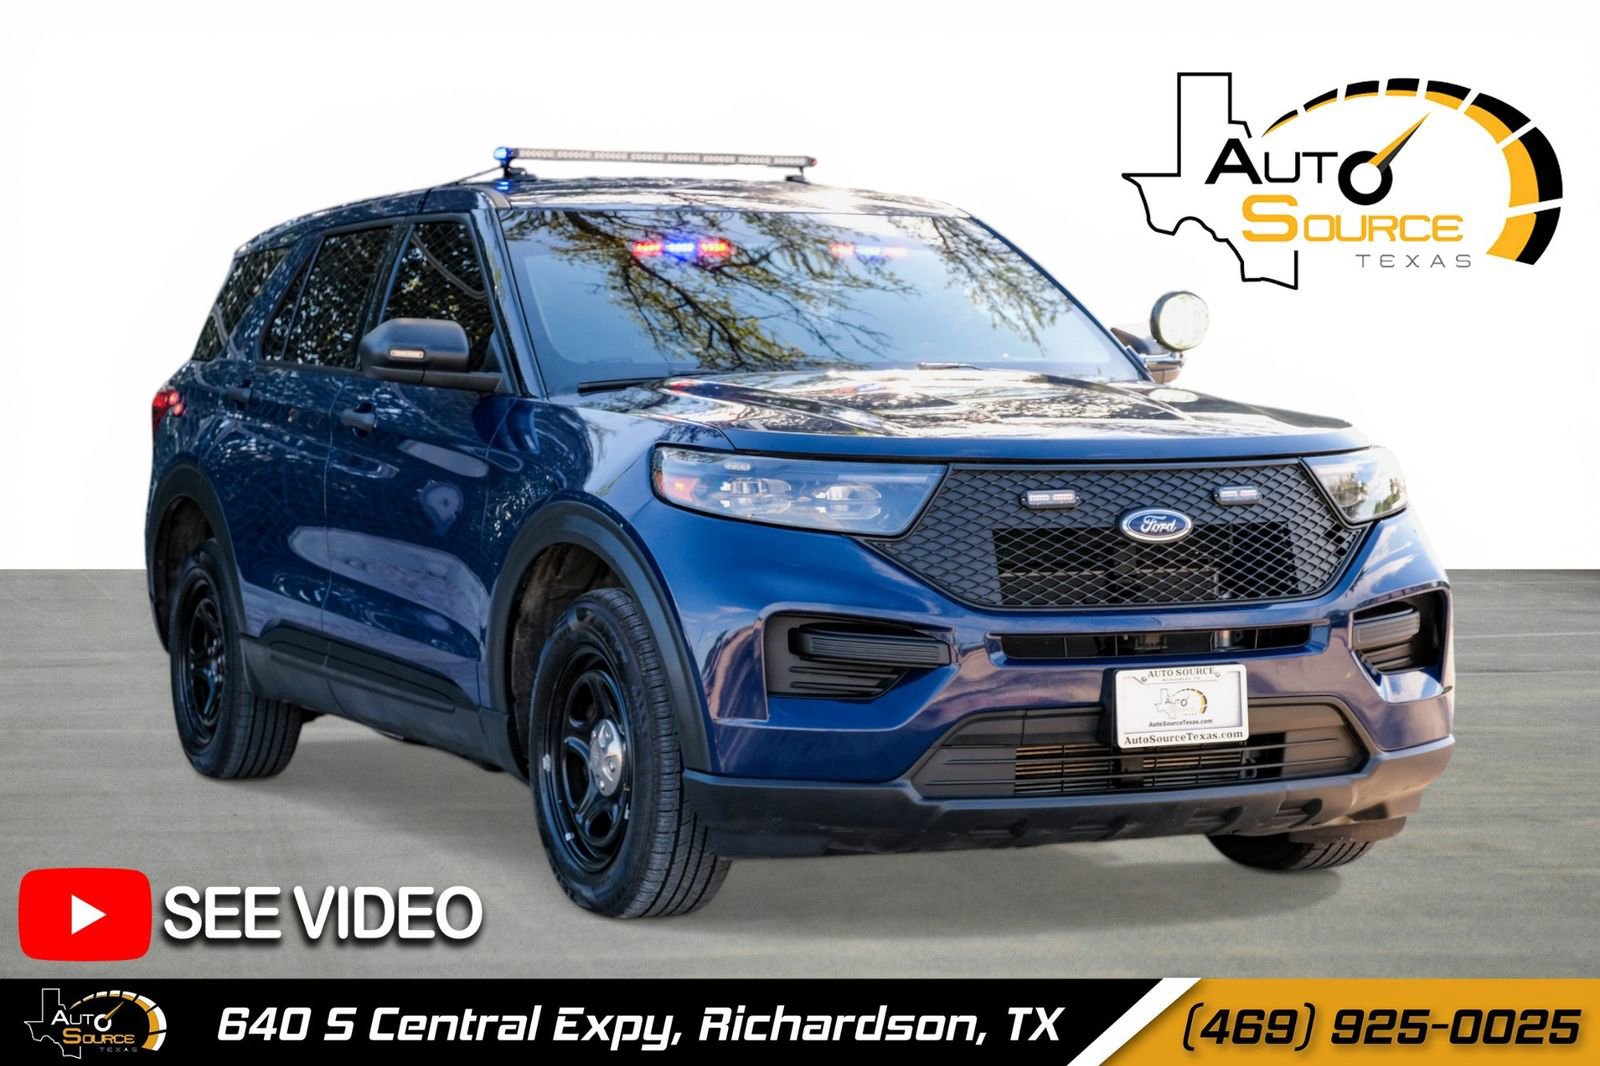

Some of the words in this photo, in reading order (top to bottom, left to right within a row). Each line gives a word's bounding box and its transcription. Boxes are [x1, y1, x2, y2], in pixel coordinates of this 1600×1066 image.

[1140, 515, 1177, 533] Ford
[1148, 669, 1173, 678] AUTO
[1175, 667, 1215, 676] SOURCE
[1149, 718, 1213, 728] AutoSourceTexas.com
[1124, 731, 1243, 746] AutoSourceTexas.com
